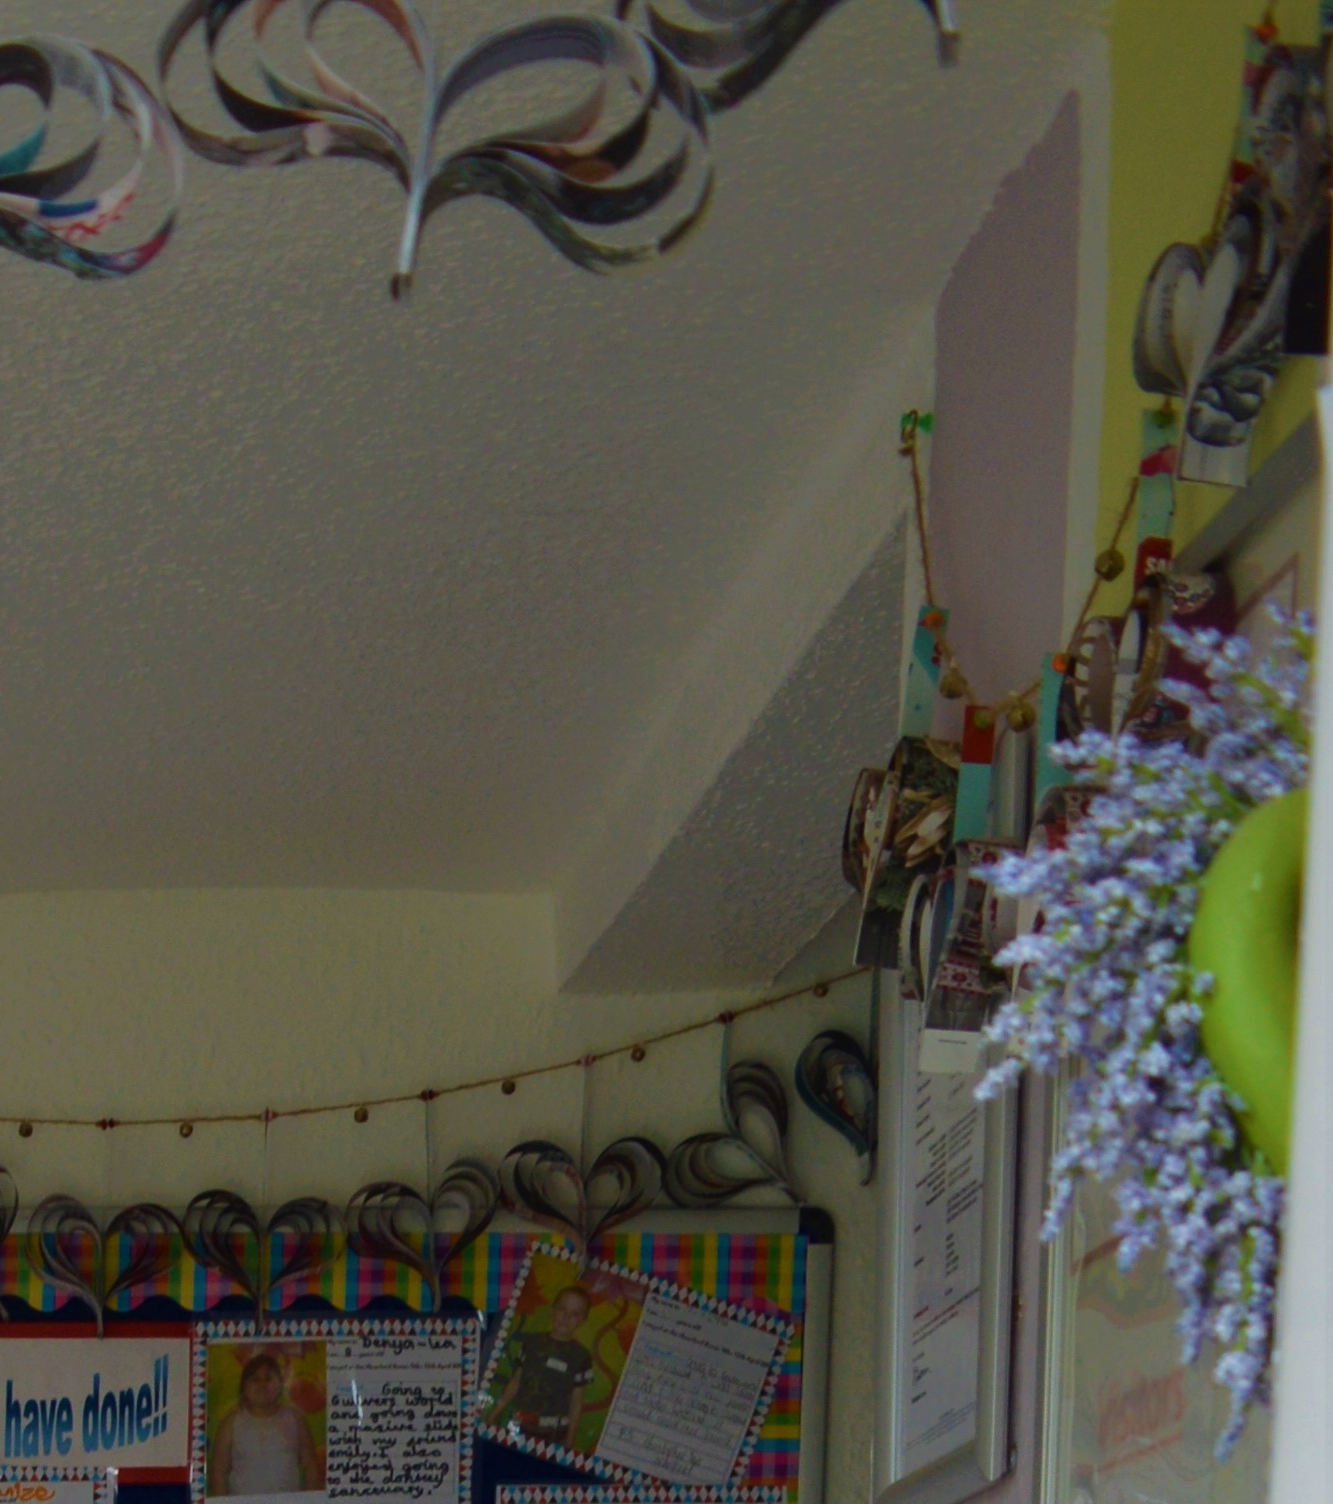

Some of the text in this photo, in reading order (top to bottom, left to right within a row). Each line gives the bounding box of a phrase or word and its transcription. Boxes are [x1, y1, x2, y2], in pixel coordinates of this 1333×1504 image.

[382, 1382, 422, 1396] Going
[4, 1379, 73, 1458] have
[82, 1354, 169, 1452] done!!
[406, 1394, 453, 1411] world
[371, 1409, 415, 1422] going
[373, 1436, 397, 1447] my
[403, 1447, 442, 1457] also
[403, 1460, 449, 1474] going
